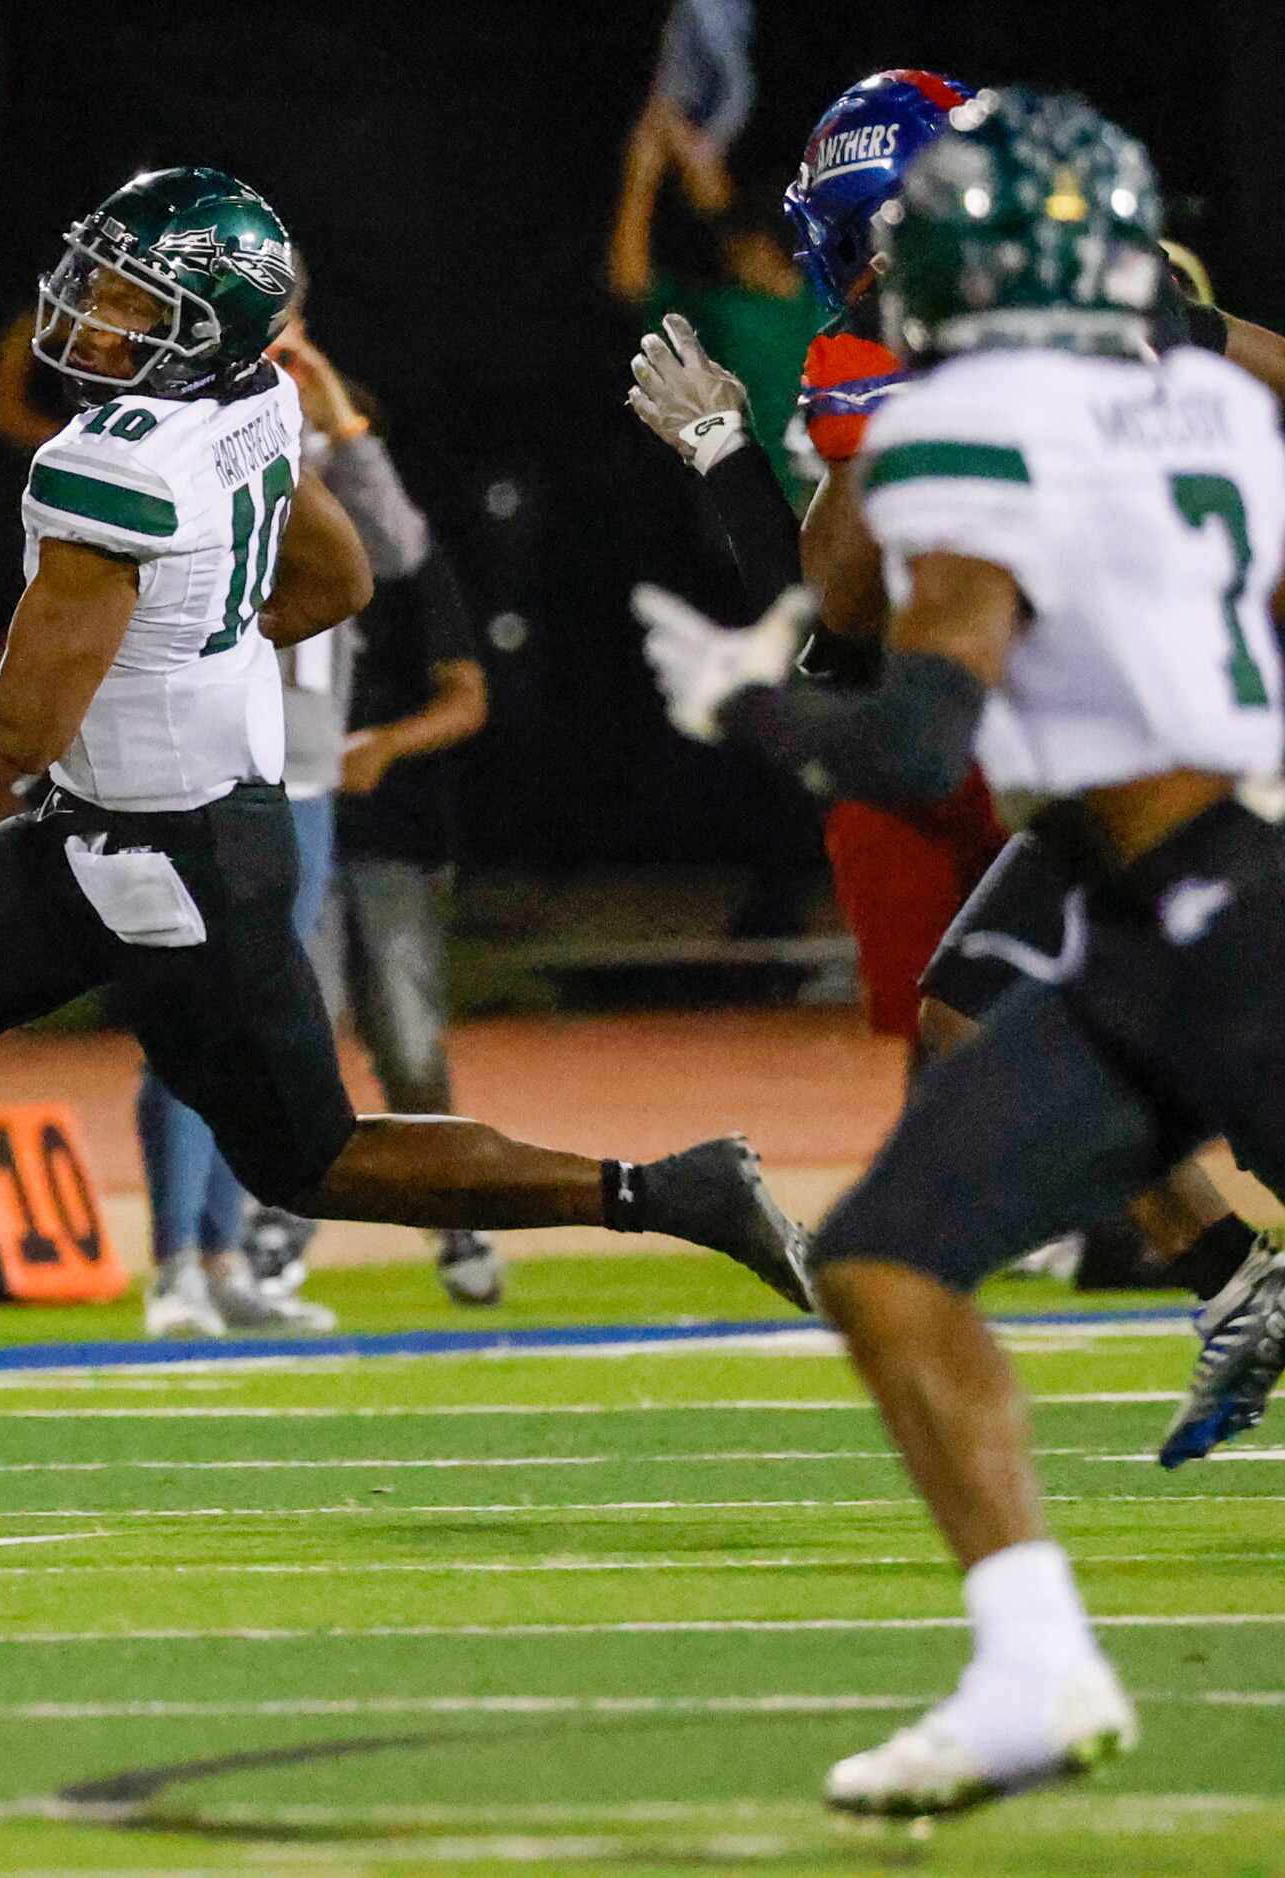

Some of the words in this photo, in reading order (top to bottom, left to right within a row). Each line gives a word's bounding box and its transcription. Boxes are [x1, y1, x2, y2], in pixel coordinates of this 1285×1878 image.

[816, 123, 901, 173] ANTHERS
[80, 402, 158, 441] 10
[199, 453, 297, 658] 10
[1166, 470, 1269, 707] 7
